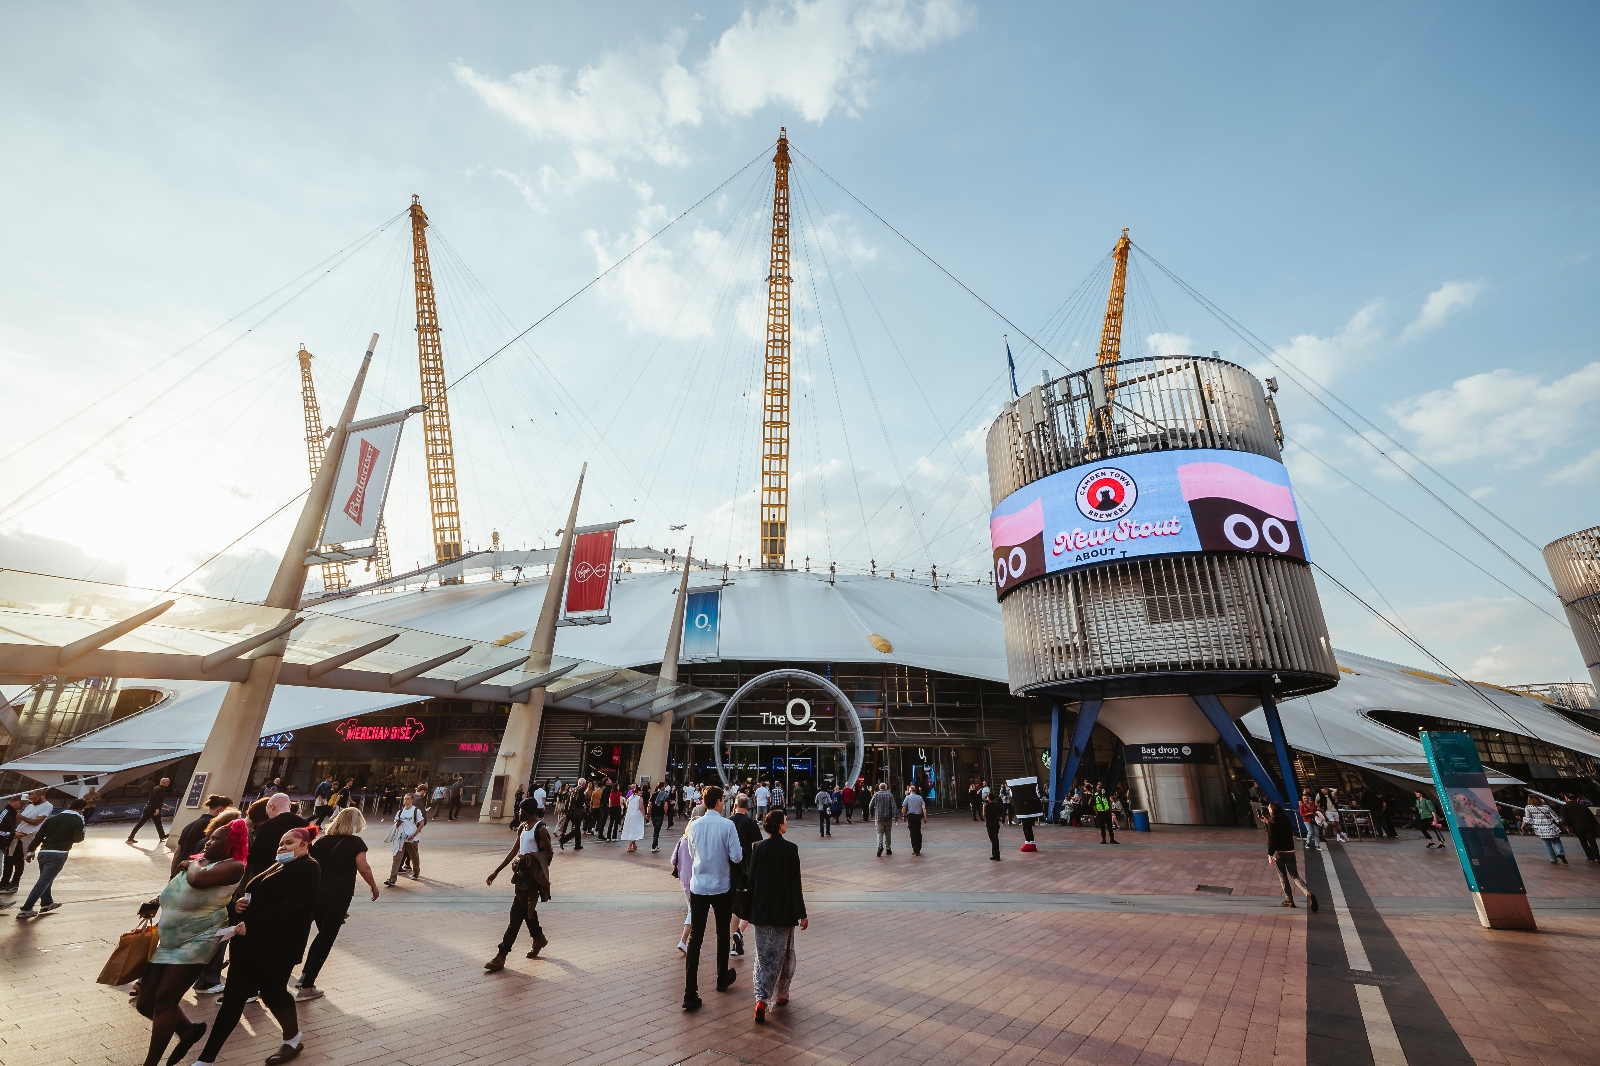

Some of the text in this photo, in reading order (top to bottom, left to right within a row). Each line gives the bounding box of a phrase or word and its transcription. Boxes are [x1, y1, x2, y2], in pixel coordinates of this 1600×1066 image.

[348, 444, 374, 518] Budweiser
[1080, 471, 1131, 496] CAMDEN TOWN
[1088, 502, 1128, 519] BREWERY
[1052, 516, 1182, 557] New Stout
[1075, 548, 1116, 562] ABOUT
[760, 712, 786, 725] The
[1141, 745, 1179, 756] Bag drop
